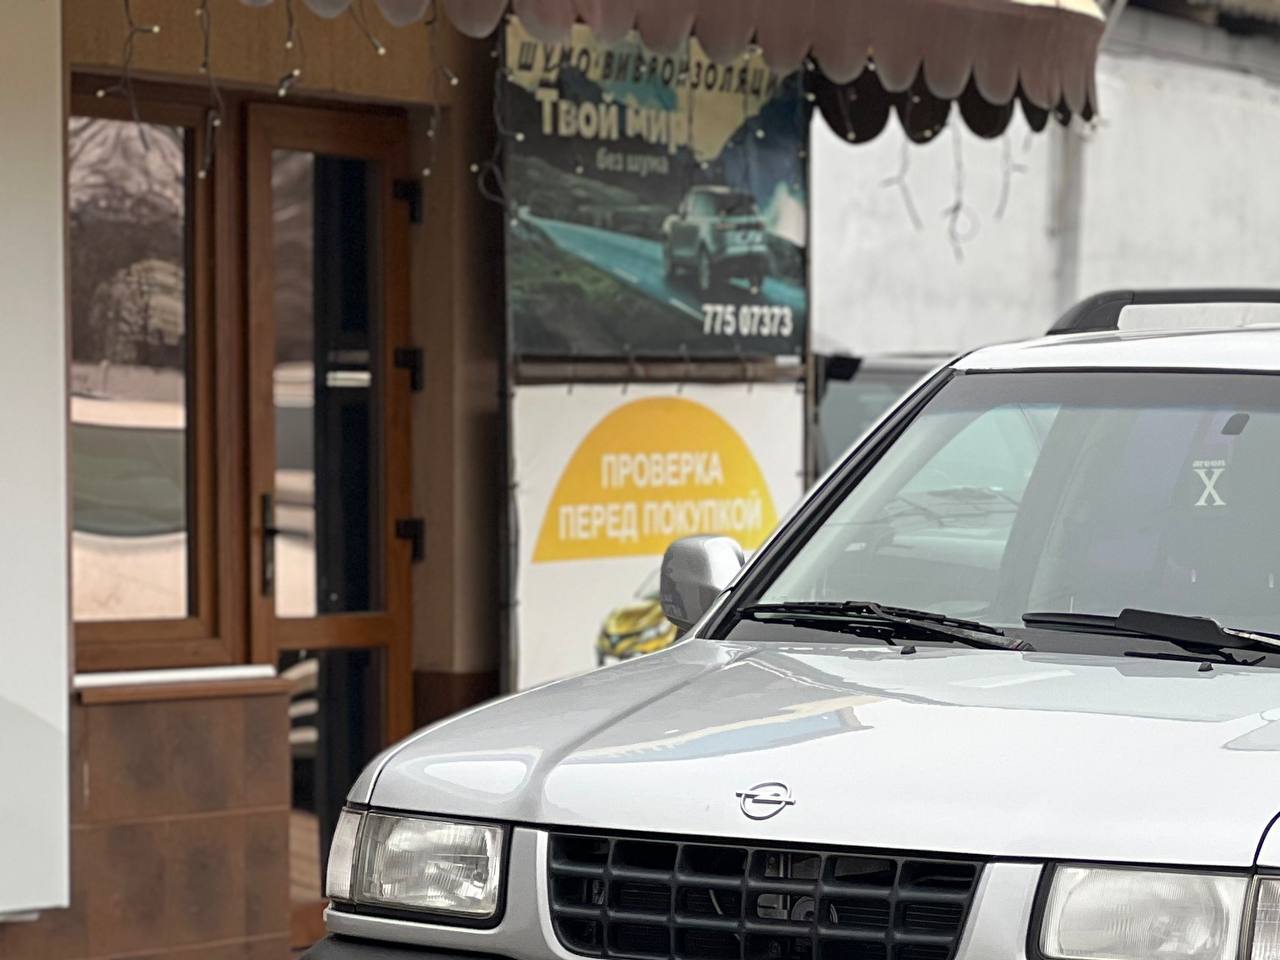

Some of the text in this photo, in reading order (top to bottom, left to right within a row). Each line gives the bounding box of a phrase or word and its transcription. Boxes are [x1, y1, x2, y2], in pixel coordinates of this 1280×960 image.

[535, 88, 619, 140] Твой
[702, 304, 793, 337] 775 07373
[601, 451, 724, 490] ПРОВЕРКА
[1192, 468, 1227, 506] X
[558, 489, 764, 544] ПЕРЕД ПОКУПКОЙ
